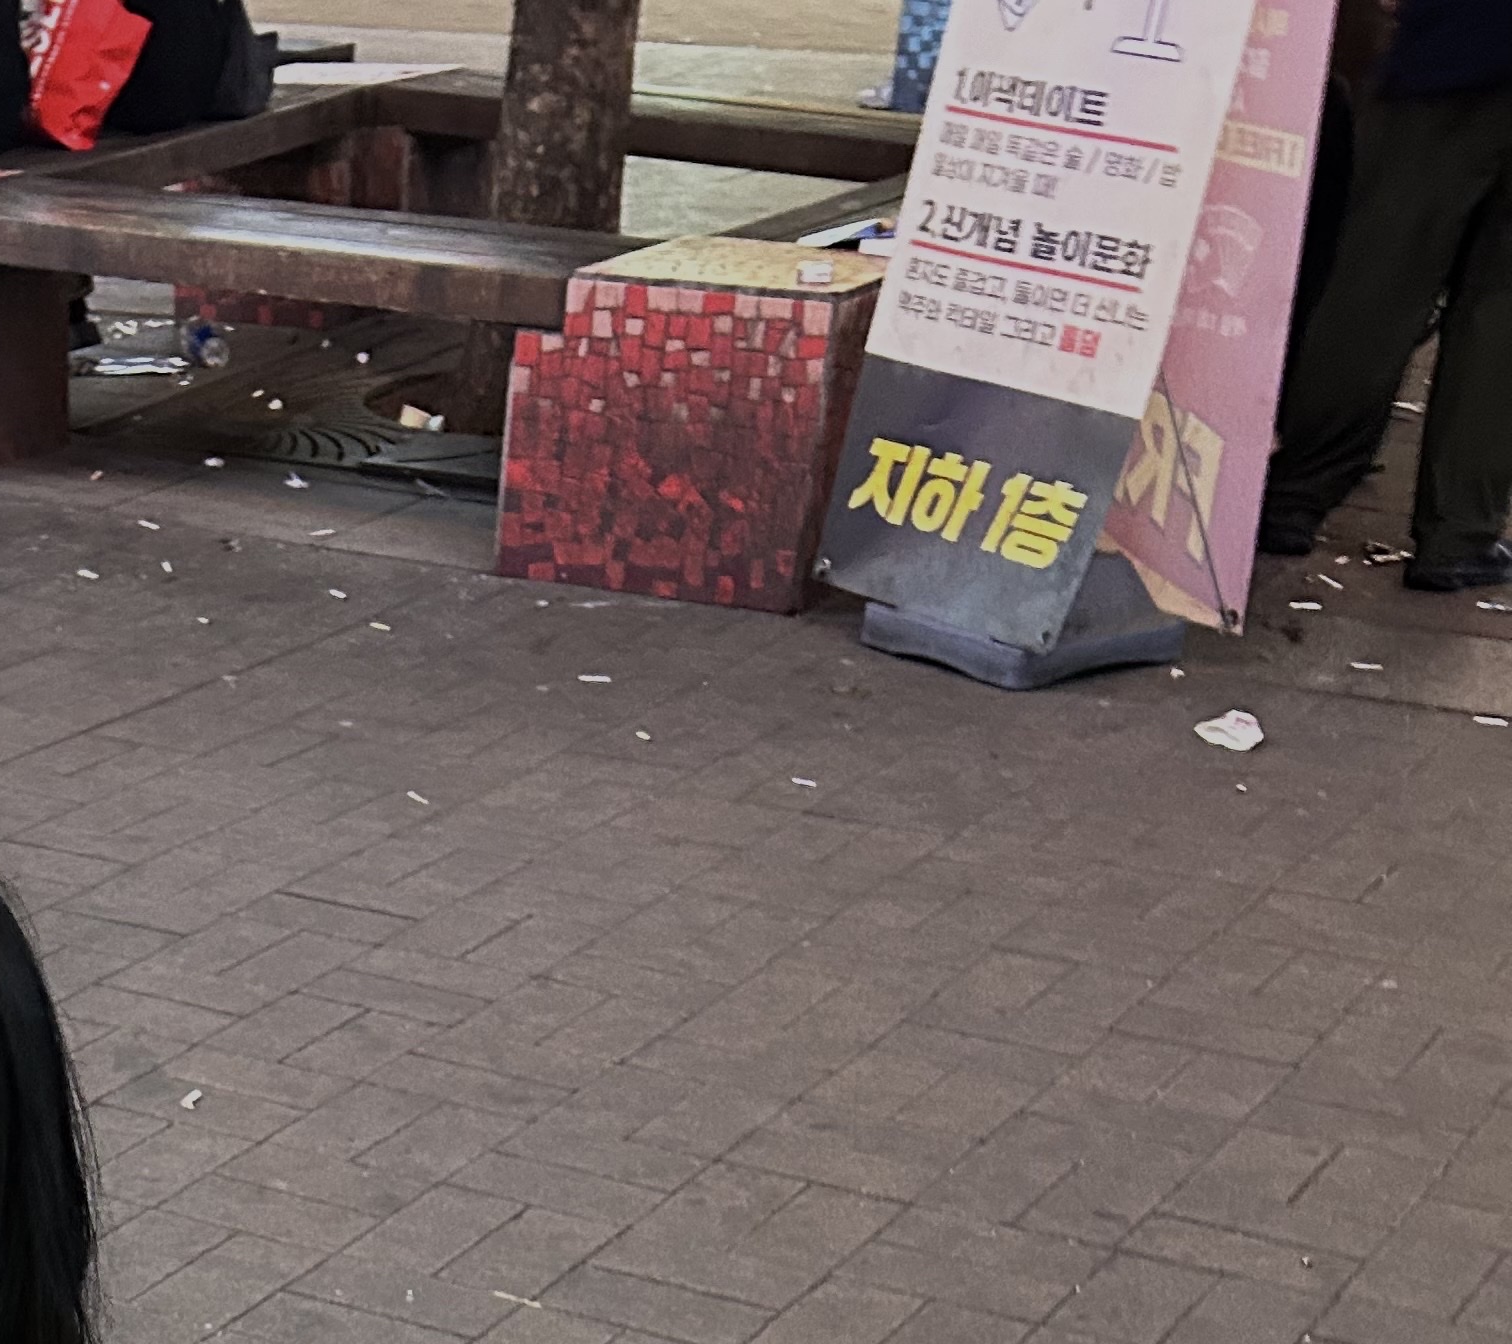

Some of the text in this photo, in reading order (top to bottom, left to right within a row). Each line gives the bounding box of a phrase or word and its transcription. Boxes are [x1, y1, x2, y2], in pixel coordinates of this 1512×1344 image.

[917, 199, 1154, 279] 2.신개념 놀이문화
[1000, 314, 1057, 347] 그리고
[847, 437, 1089, 569] 지하 1층
